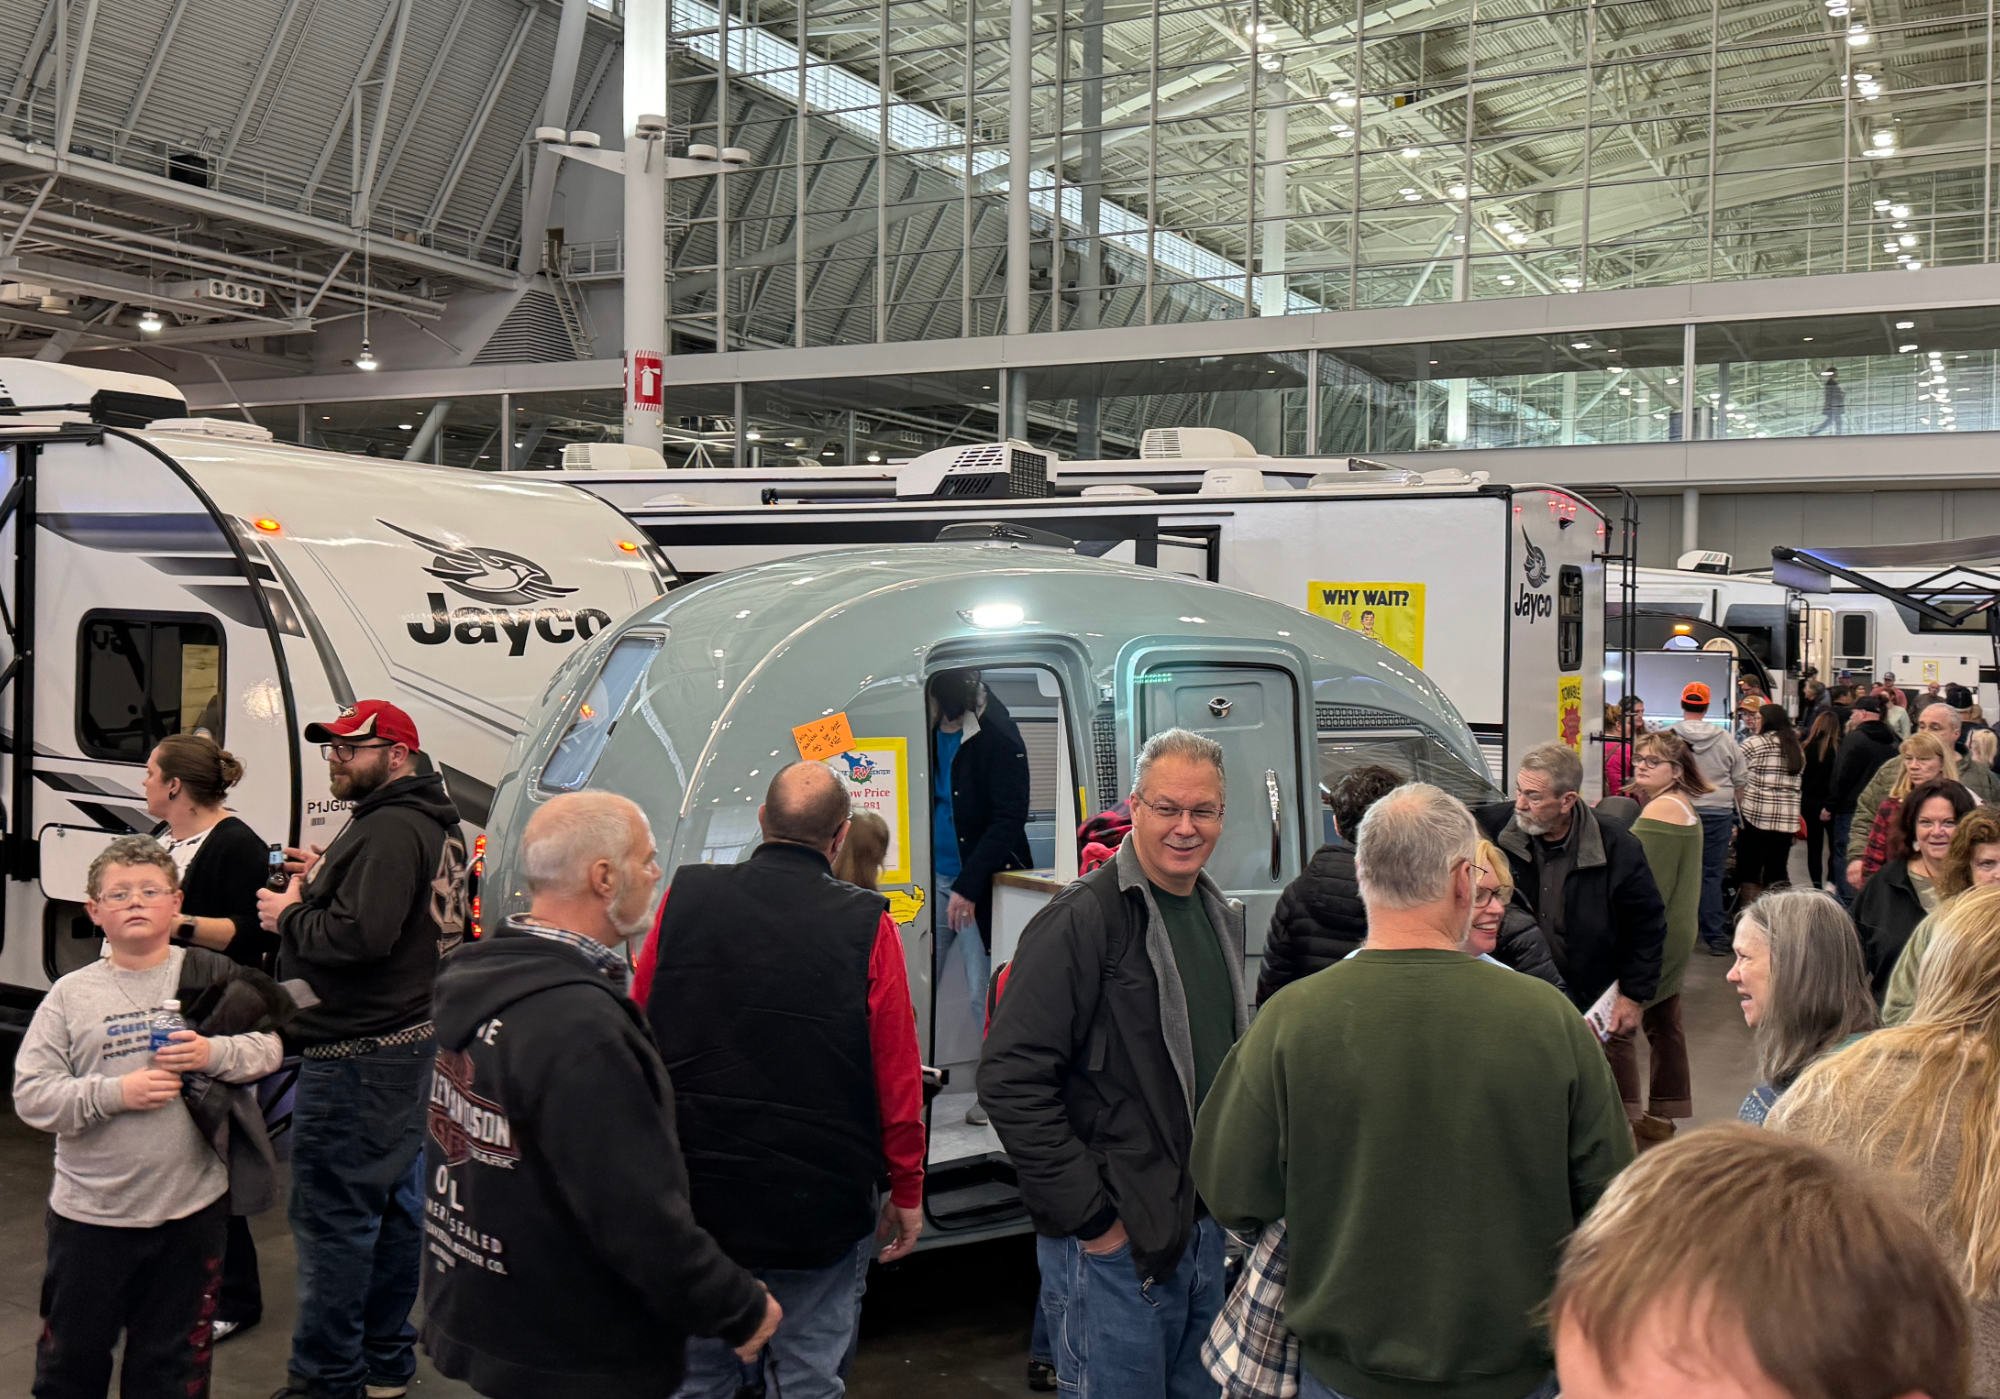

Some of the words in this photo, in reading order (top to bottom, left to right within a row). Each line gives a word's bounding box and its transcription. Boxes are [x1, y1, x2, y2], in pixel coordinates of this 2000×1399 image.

[1322, 590, 1359, 605] WHY
[1363, 591, 1410, 606] WAIT?
[1514, 583, 1552, 624] Jayco
[406, 592, 612, 656] Jayco
[853, 766, 870, 779] RV
[864, 788, 890, 797] Price
